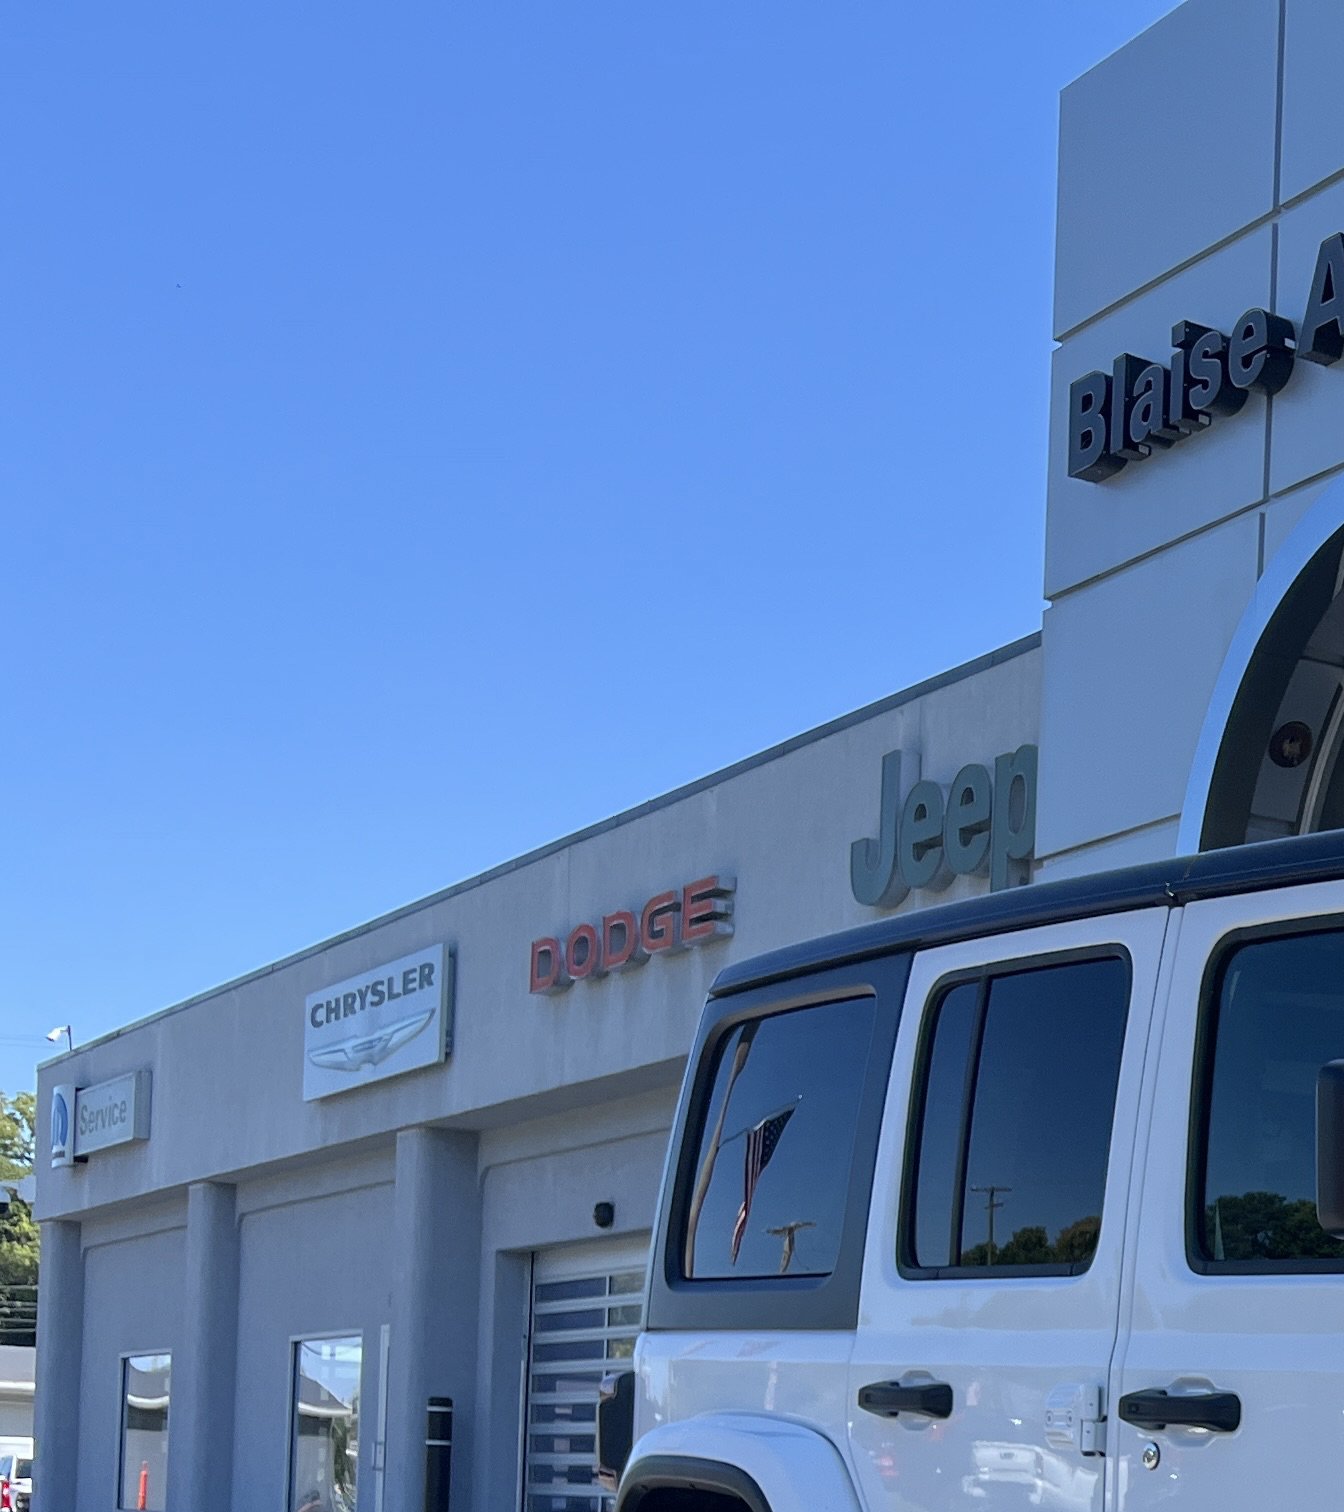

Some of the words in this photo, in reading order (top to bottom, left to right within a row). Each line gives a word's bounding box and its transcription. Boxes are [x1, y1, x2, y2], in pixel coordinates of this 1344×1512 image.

[1068, 306, 1295, 482] Blaise
[851, 744, 1039, 907] Jeep
[530, 875, 727, 995] DODGE
[310, 961, 436, 1030] CHRYSLER
[79, 1095, 128, 1137] Service
